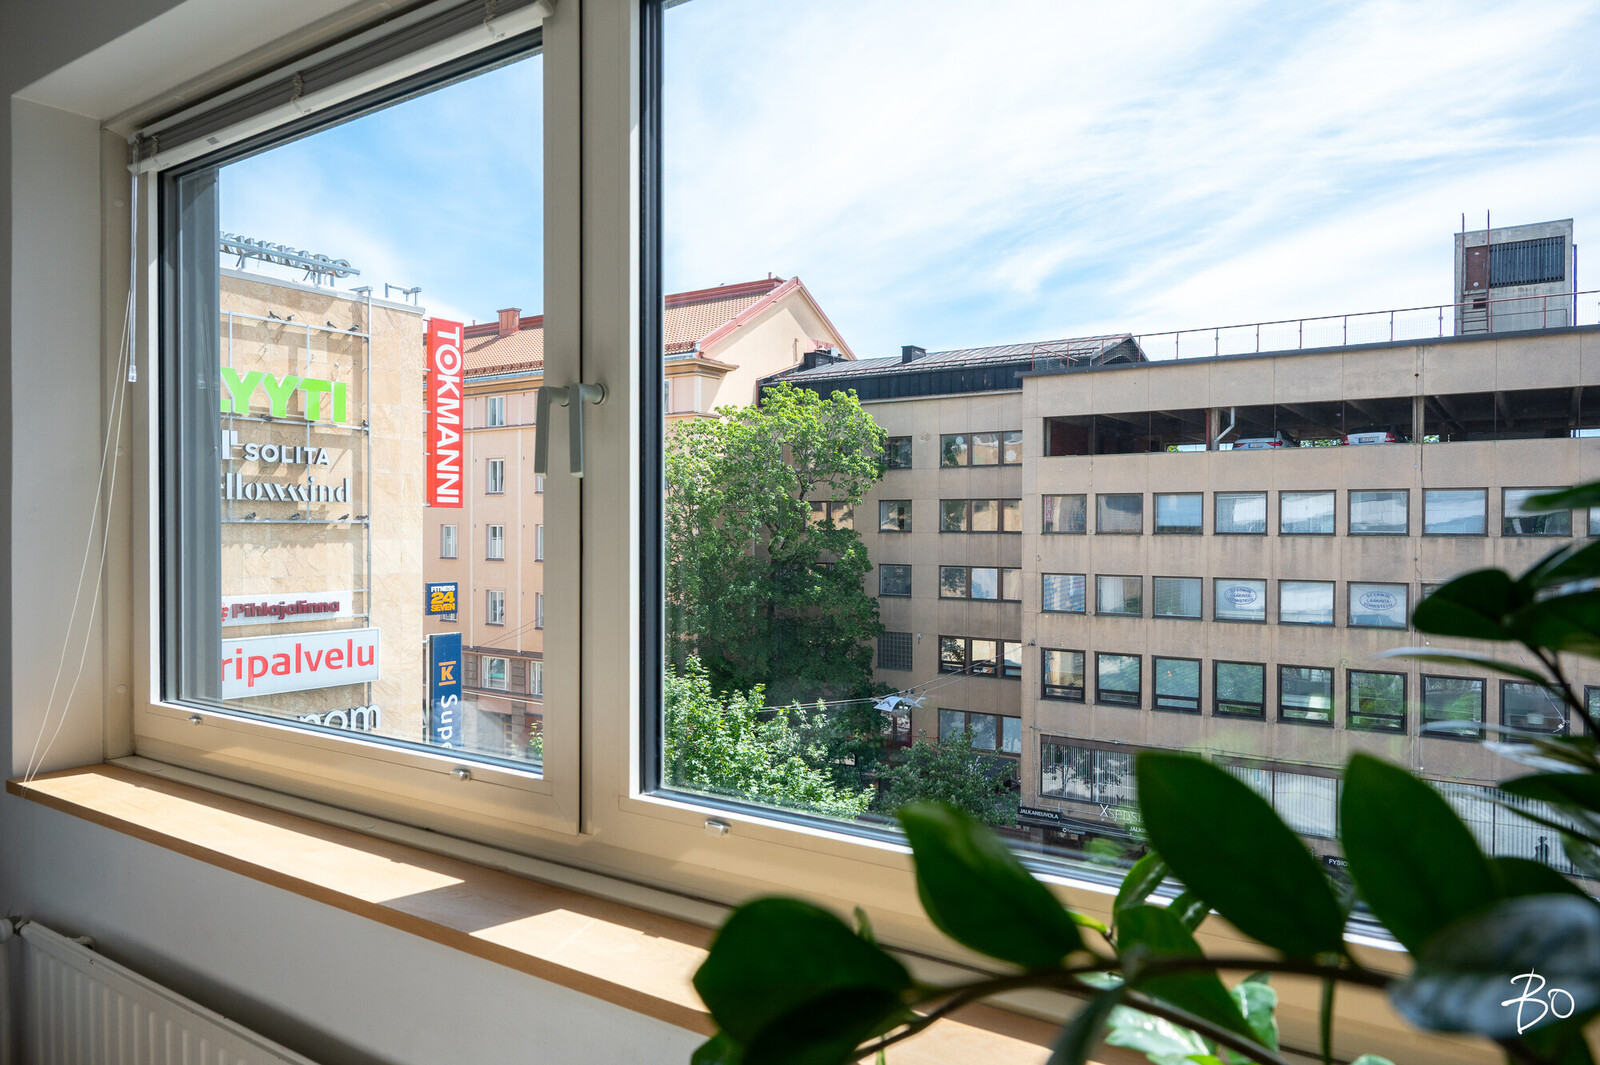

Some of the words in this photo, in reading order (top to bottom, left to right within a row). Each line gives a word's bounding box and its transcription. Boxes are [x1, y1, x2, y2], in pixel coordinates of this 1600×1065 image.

[435, 326, 462, 503] TOKMANNI
[244, 443, 330, 465] SOLITA
[430, 591, 456, 605] 24
[232, 601, 340, 620] Pihlajalinna
[430, 603, 456, 612] SEVEN
[440, 665, 454, 682] K
